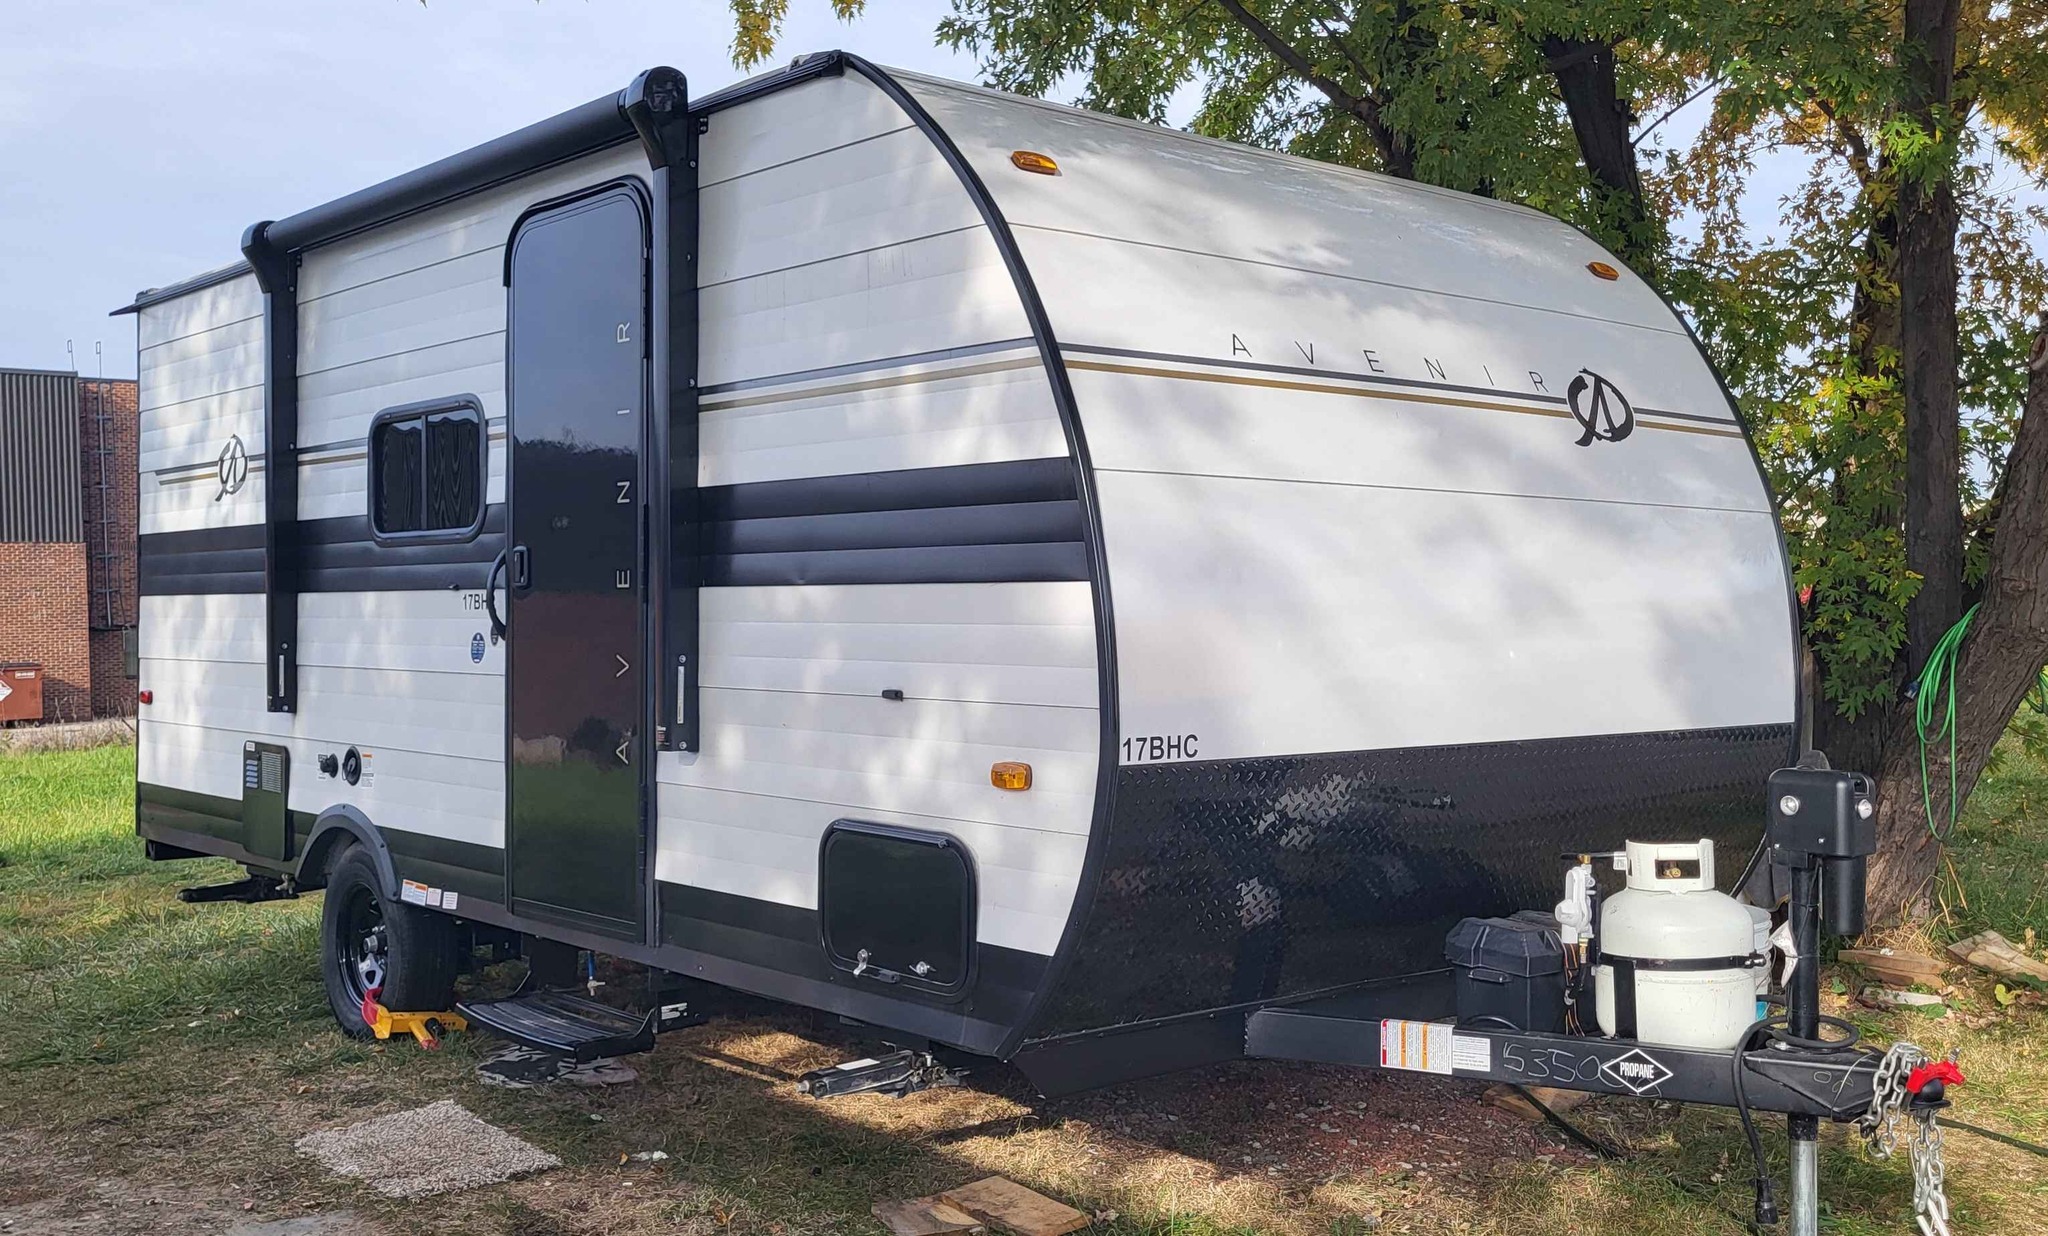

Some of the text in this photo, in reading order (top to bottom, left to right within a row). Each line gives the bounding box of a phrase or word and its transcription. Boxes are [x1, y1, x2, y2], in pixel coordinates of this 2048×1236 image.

[1232, 333, 1549, 393] AVENIR
[615, 322, 630, 765] AVENIR
[463, 593, 489, 611] 17BH
[1122, 734, 1199, 762] 17BHC
[1619, 1061, 1655, 1079] PROPANE
